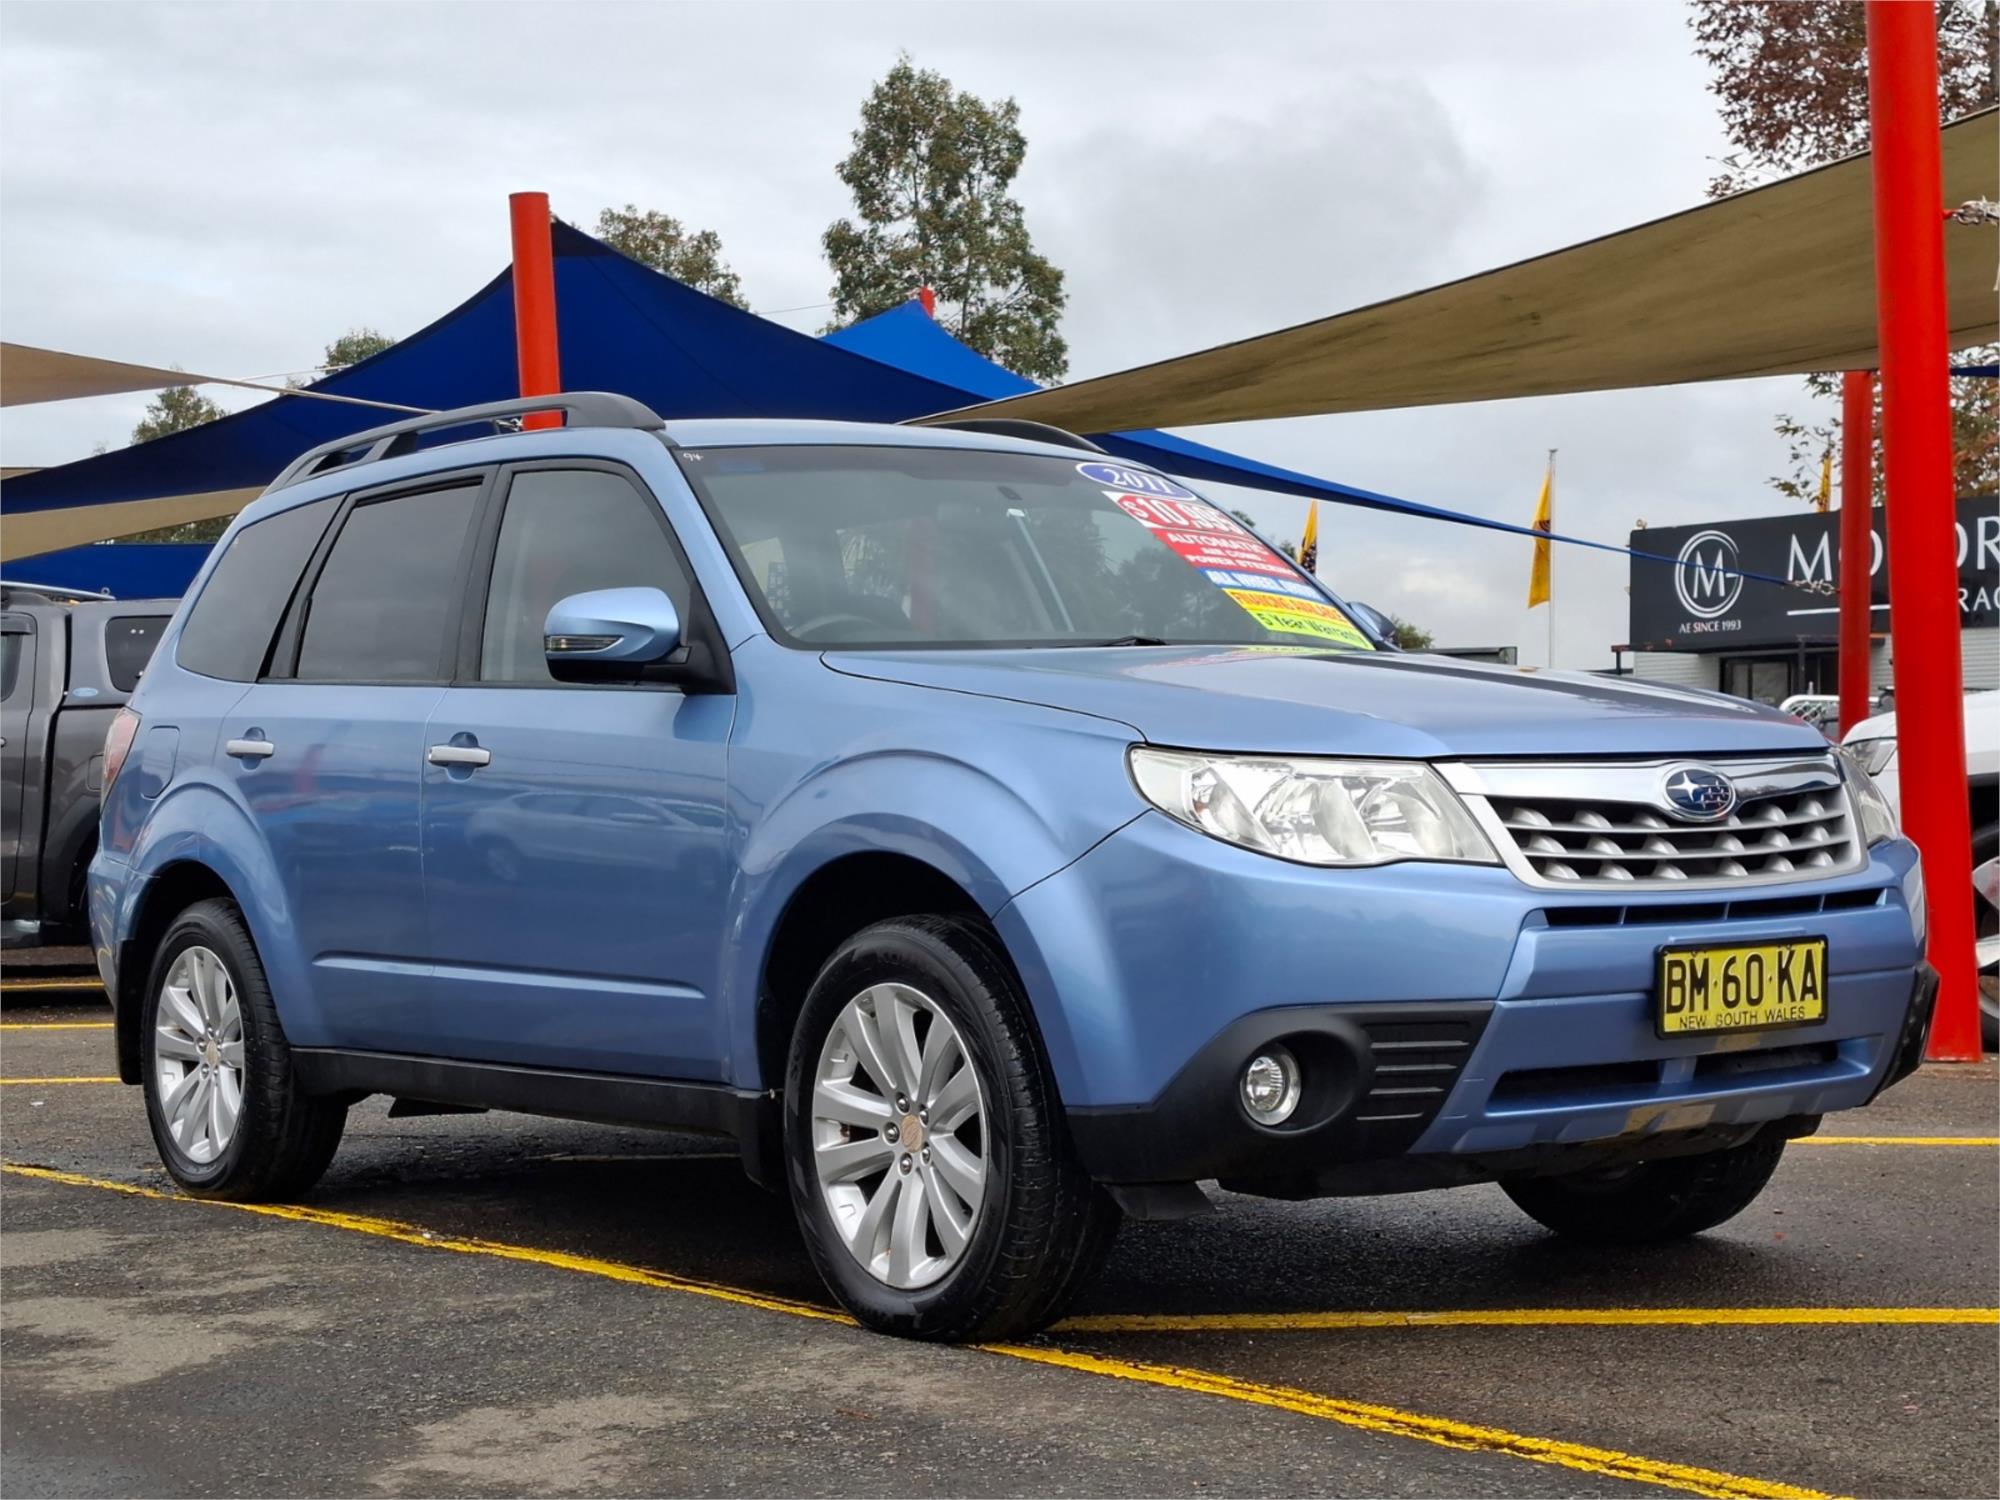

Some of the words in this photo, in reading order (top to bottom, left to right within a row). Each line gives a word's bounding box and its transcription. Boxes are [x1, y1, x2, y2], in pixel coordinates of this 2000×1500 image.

[1103, 468, 1174, 494] 2011
[1167, 532, 1269, 556] AUTOMATIC
[1257, 612, 1273, 627] 5
[1275, 614, 1305, 632] Year
[1693, 621, 1720, 633] SINCE
[1722, 619, 1742, 631] 1993
[1680, 1014, 1708, 1030] NEW
[1715, 1010, 1758, 1026] SOUTH
[1765, 1006, 1806, 1022] WALES
